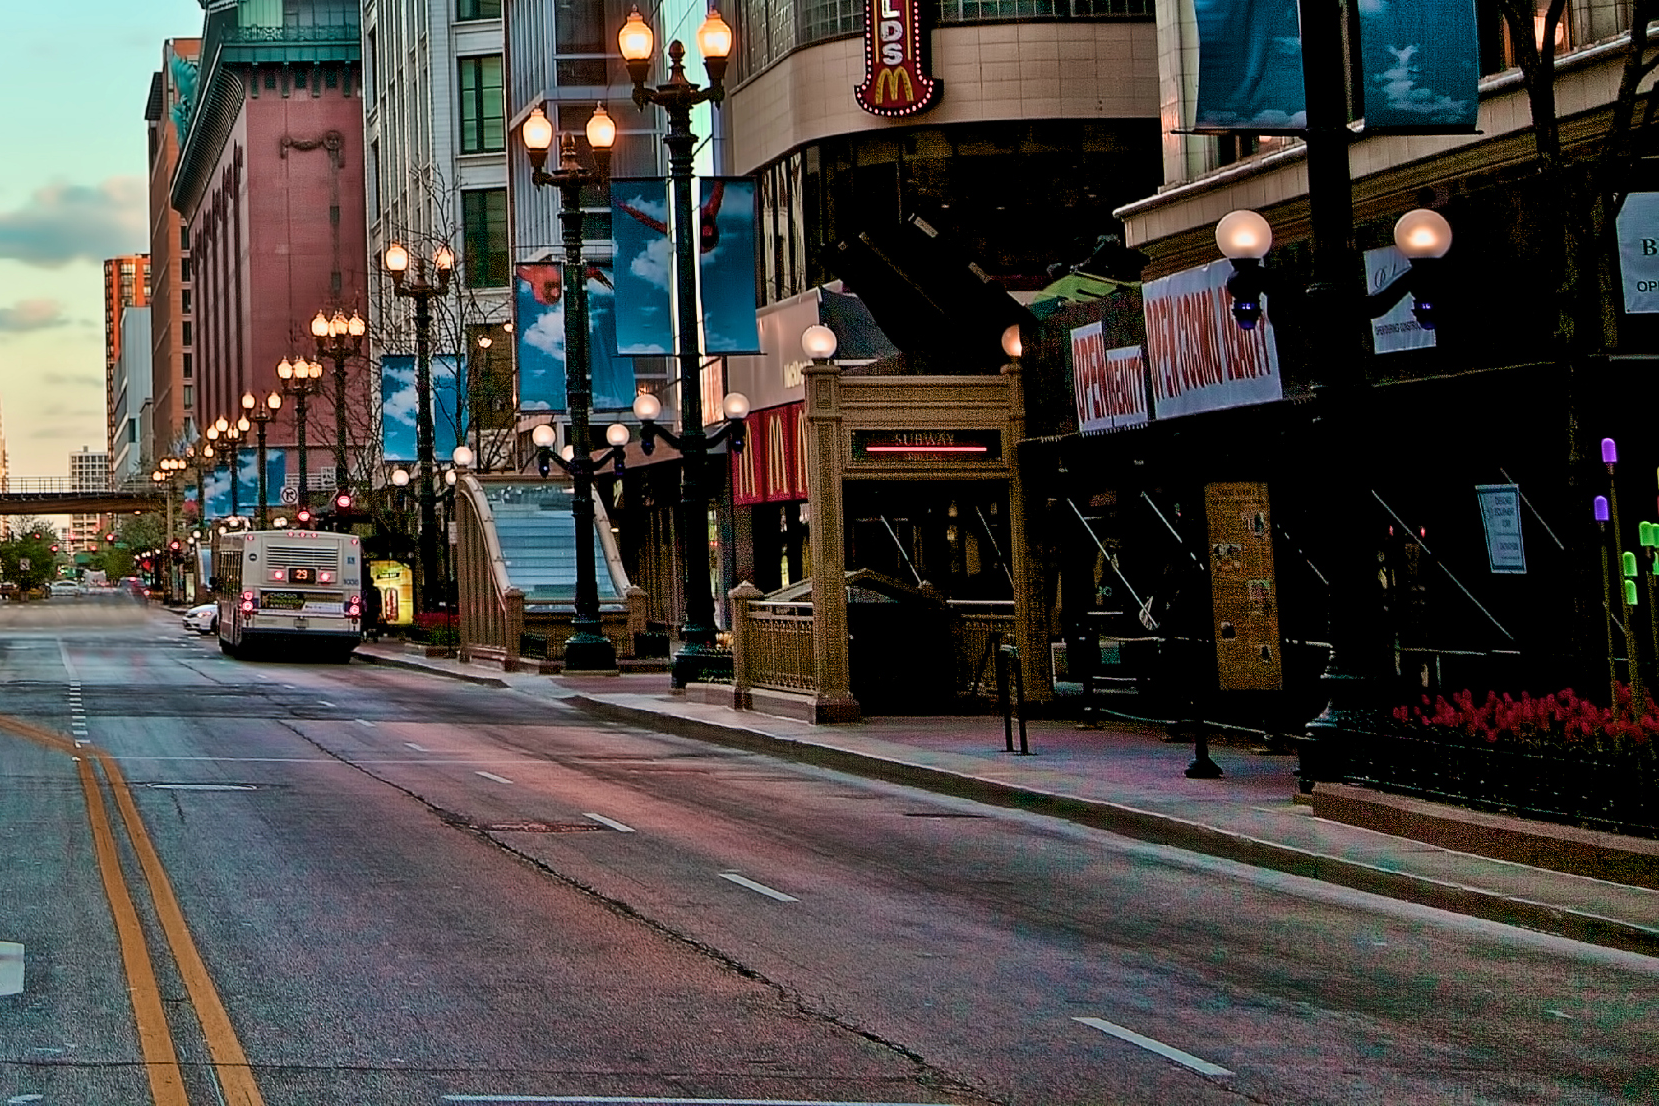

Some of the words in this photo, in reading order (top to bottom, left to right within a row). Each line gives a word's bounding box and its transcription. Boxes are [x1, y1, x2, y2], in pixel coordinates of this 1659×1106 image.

[1636, 280, 1659, 292] OP
[1073, 332, 1111, 424] OPEN
[1107, 356, 1145, 416] BEAUTY
[1145, 295, 1182, 403] OPEN
